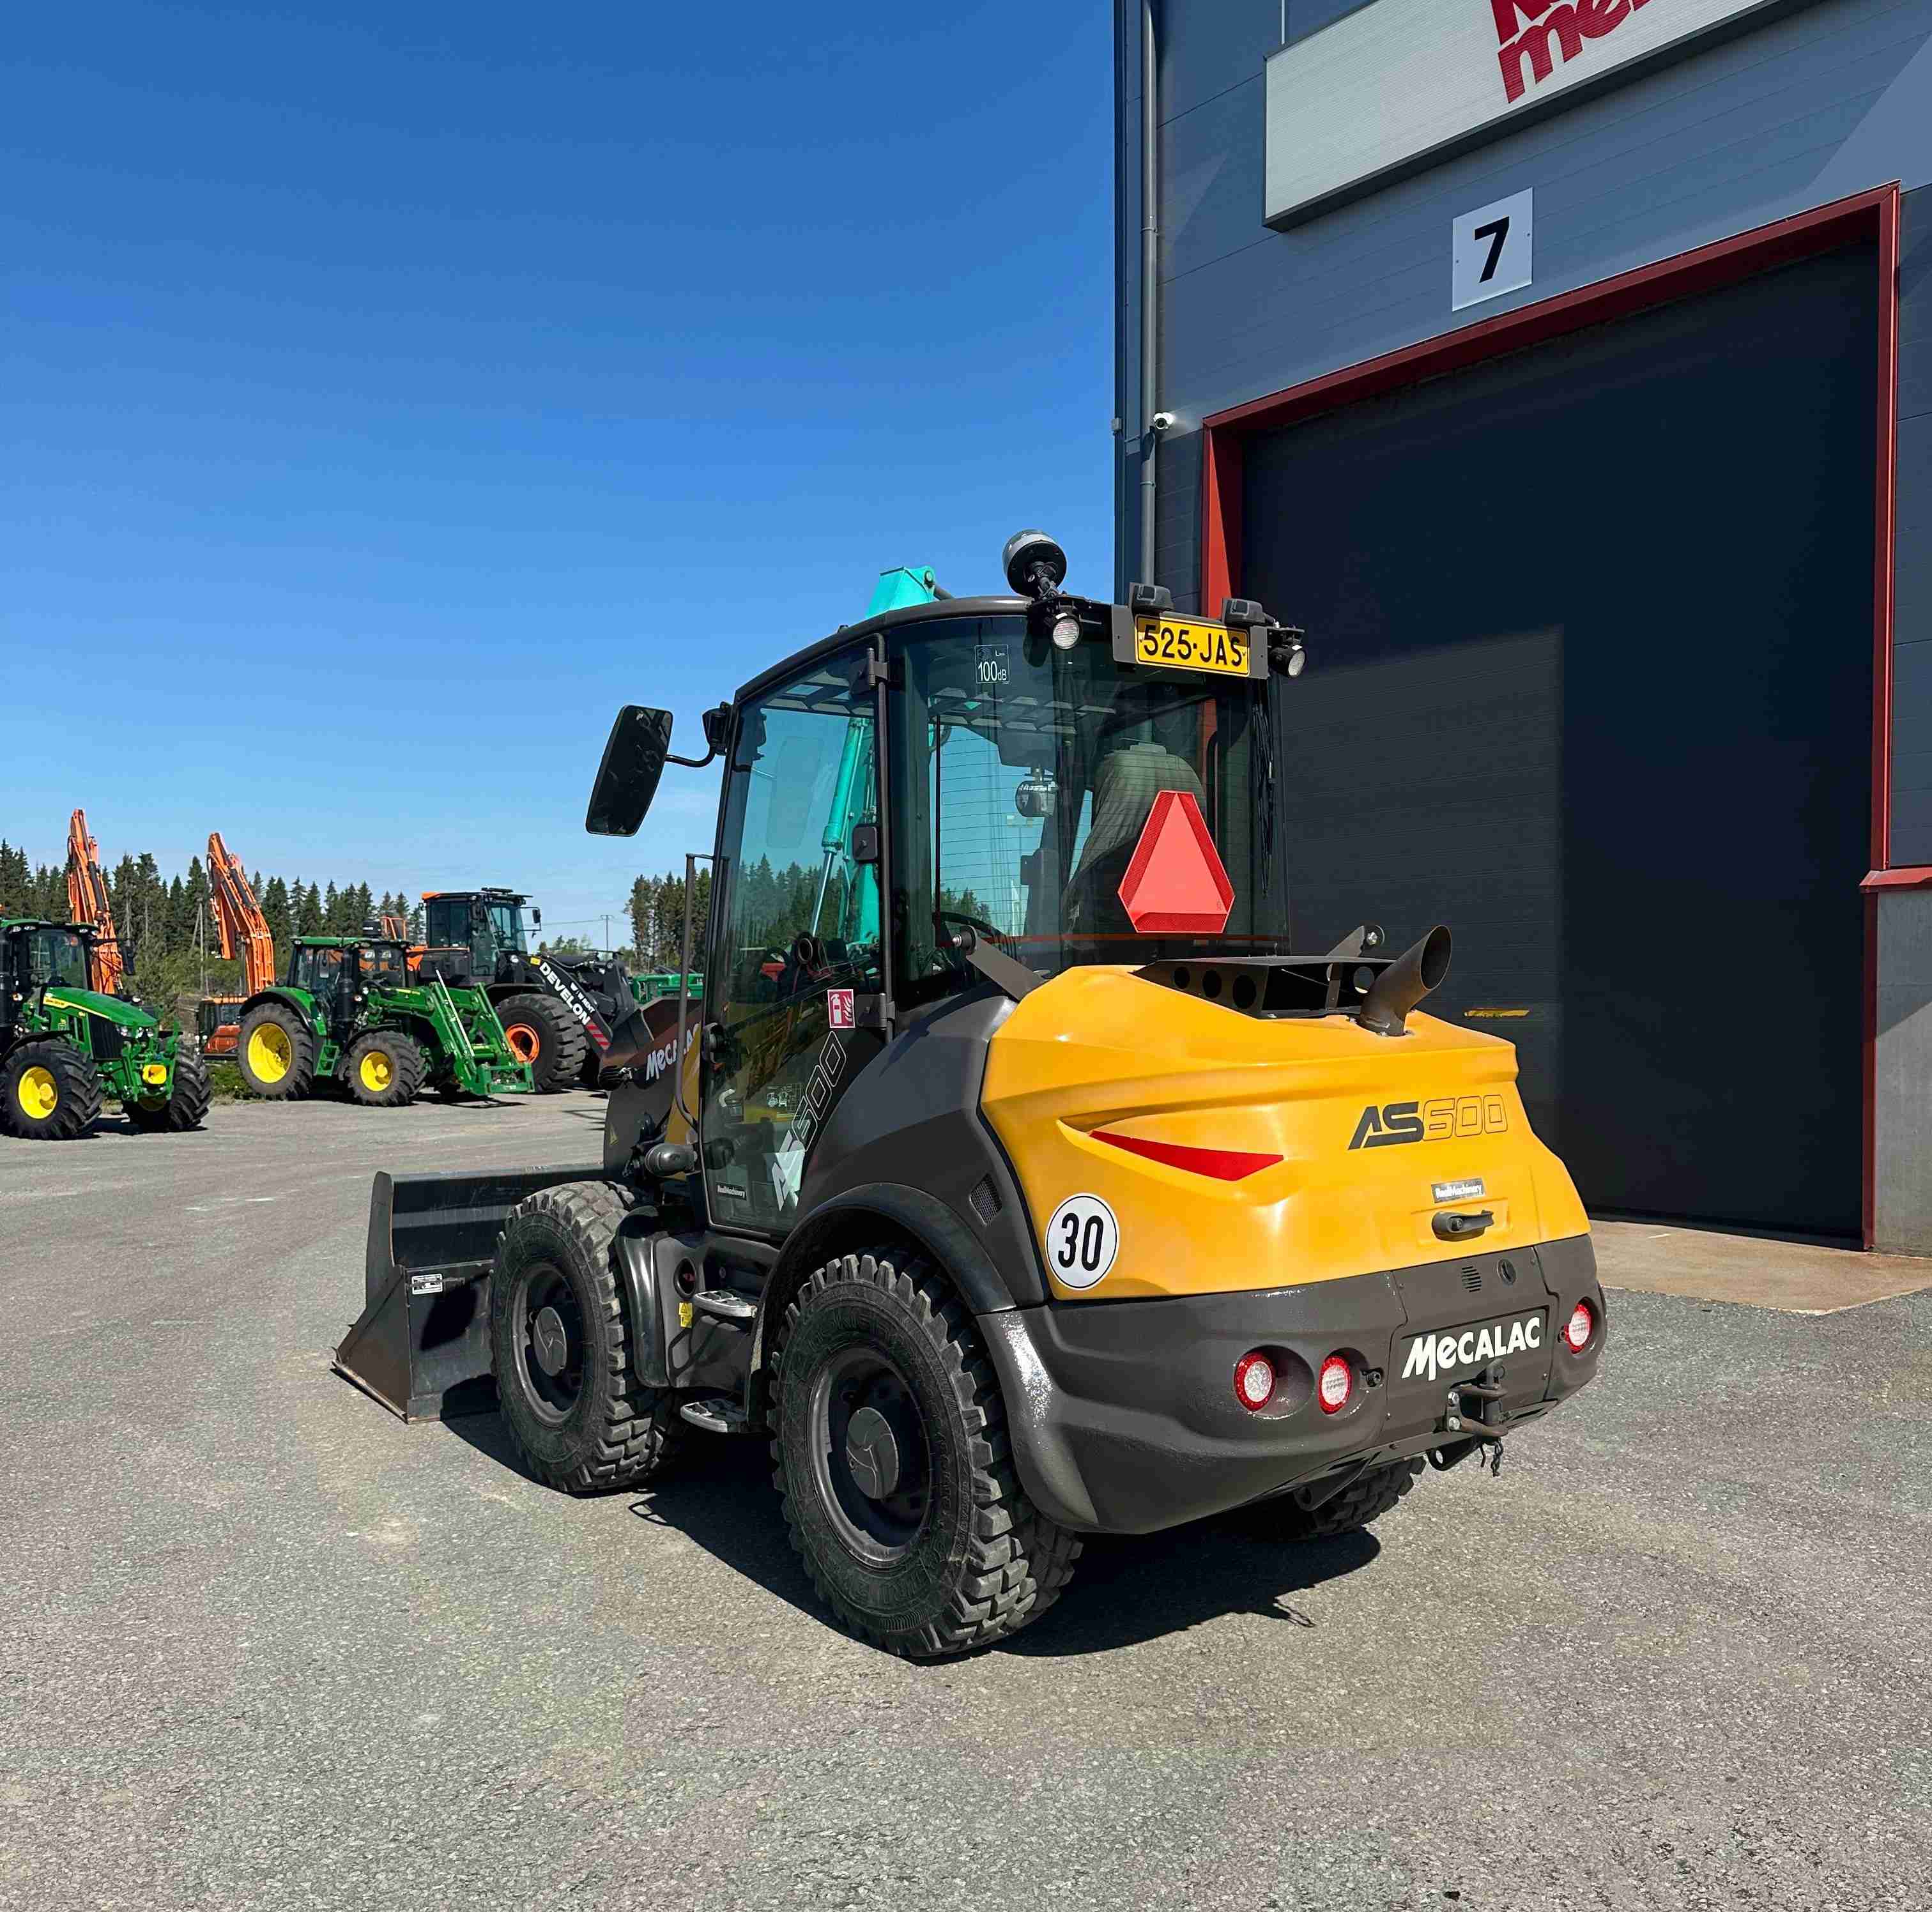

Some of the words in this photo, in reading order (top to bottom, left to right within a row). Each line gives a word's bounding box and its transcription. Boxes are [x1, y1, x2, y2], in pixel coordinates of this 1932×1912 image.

[1474, 215, 1510, 284] 7
[539, 961, 591, 1025] DEVELON
[1347, 1094, 1508, 1151] AS600
[1057, 1212, 1104, 1271] 30
